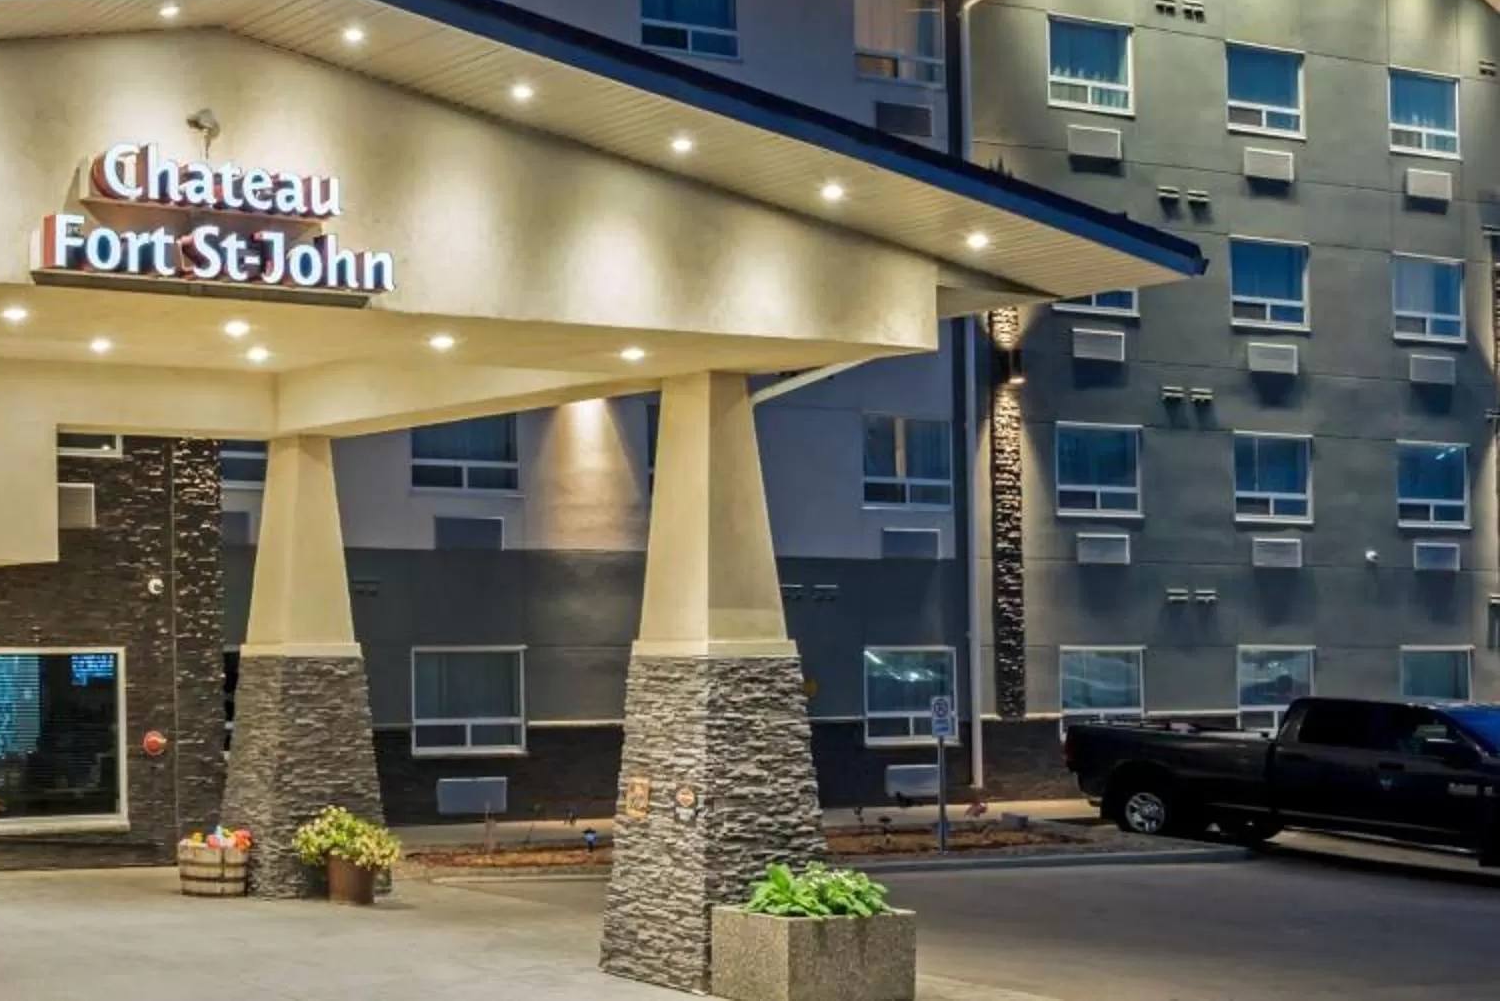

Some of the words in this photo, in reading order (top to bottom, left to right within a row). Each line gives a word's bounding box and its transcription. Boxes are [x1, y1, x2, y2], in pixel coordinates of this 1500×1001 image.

[100, 140, 342, 218] Chateau
[54, 213, 178, 278] Fort
[190, 224, 396, 292] St-John
